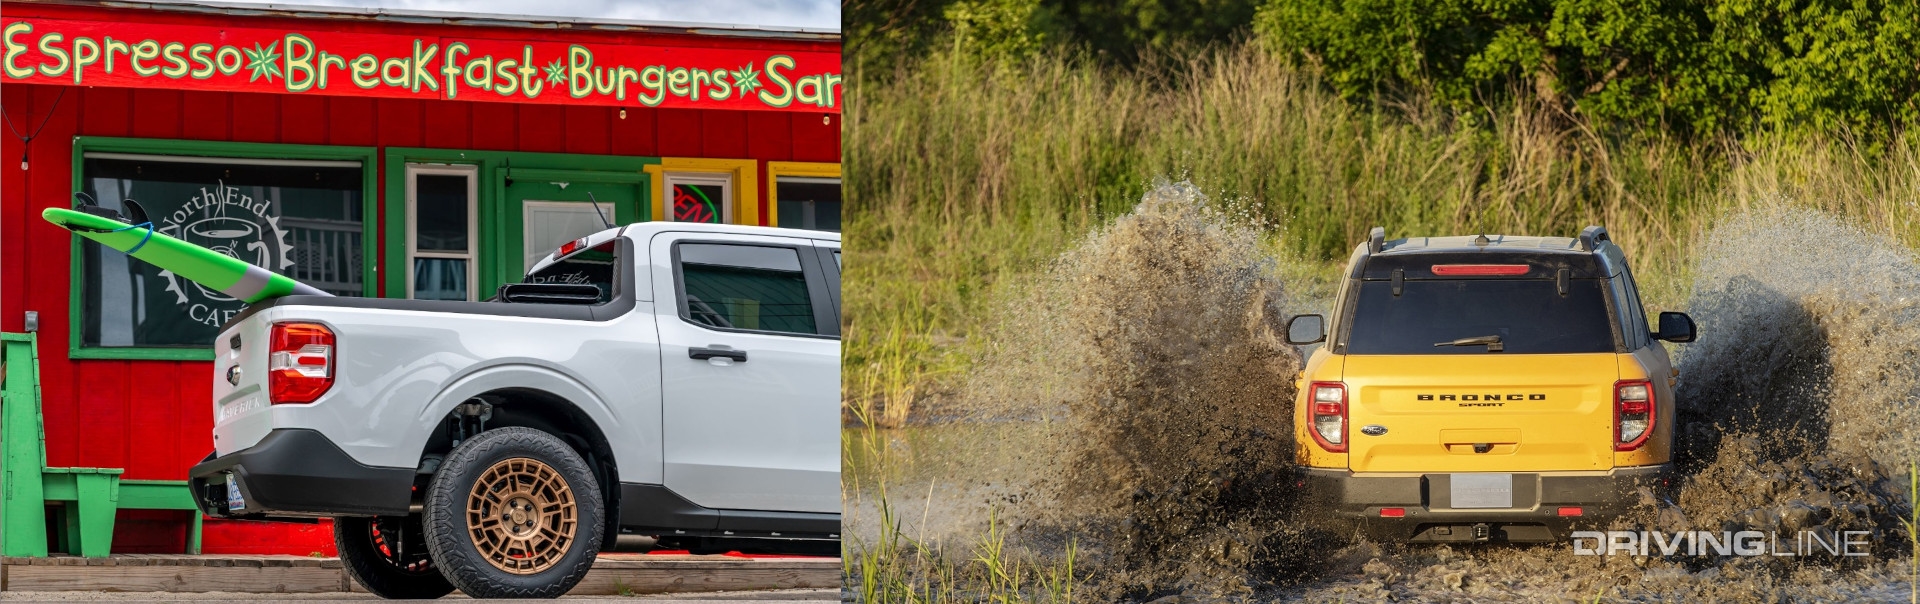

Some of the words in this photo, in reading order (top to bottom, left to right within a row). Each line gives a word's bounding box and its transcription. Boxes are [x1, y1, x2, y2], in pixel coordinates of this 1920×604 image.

[3, 22, 243, 84] Espresso
[284, 34, 543, 100] Breakfast
[569, 44, 732, 106] Burgers
[158, 187, 218, 238] North
[224, 186, 271, 218] End
